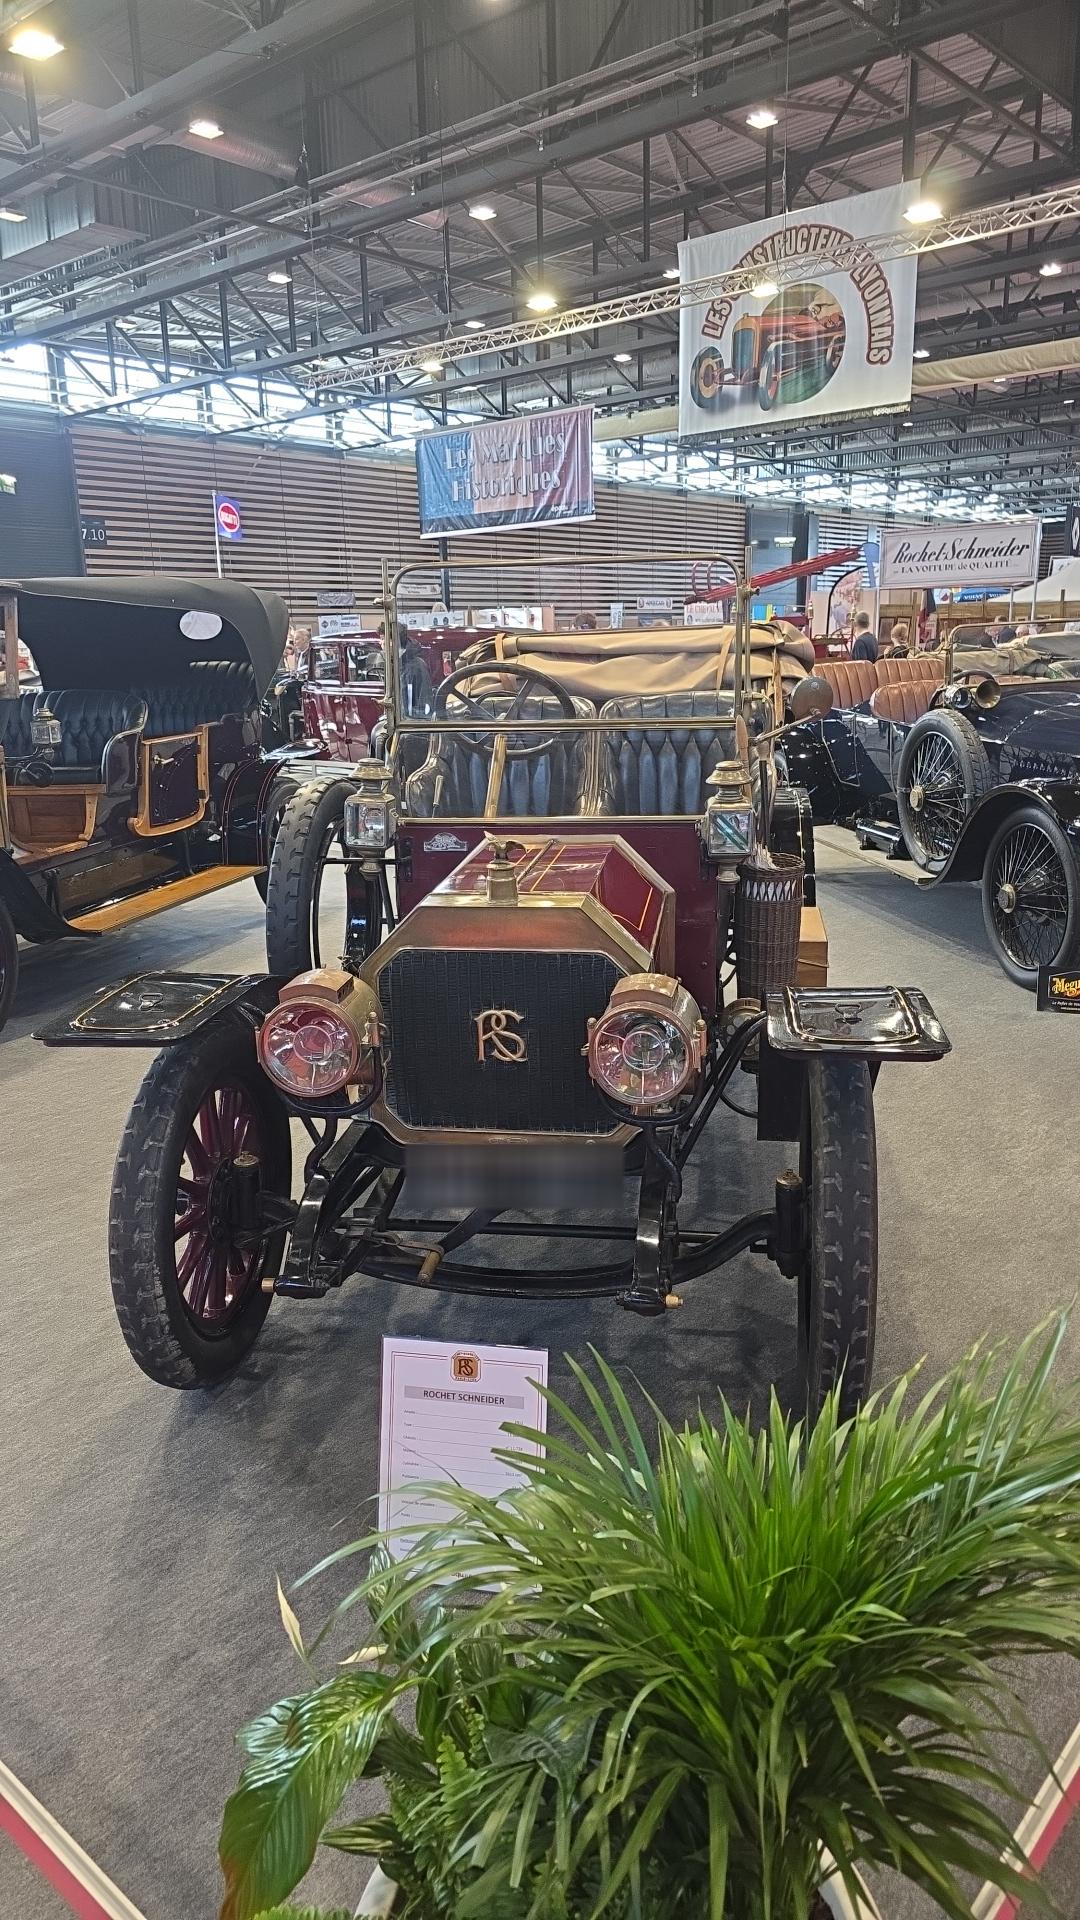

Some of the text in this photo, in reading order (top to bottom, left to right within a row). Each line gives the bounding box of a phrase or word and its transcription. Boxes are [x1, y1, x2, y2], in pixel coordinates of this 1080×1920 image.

[702, 299, 731, 339] LES
[851, 253, 893, 363] LYONNAIS
[480, 431, 565, 465] Marques
[452, 468, 561, 502] Historiques
[81, 528, 105, 541] 7.10
[893, 537, 1029, 564] Rochet-Schneider
[914, 563, 956, 573] VOITURE
[957, 562, 968, 570] de
[474, 1009, 528, 1062] RS
[458, 1358, 474, 1376] RS
[423, 1389, 505, 1405] ROCHET SCHNEIDER
